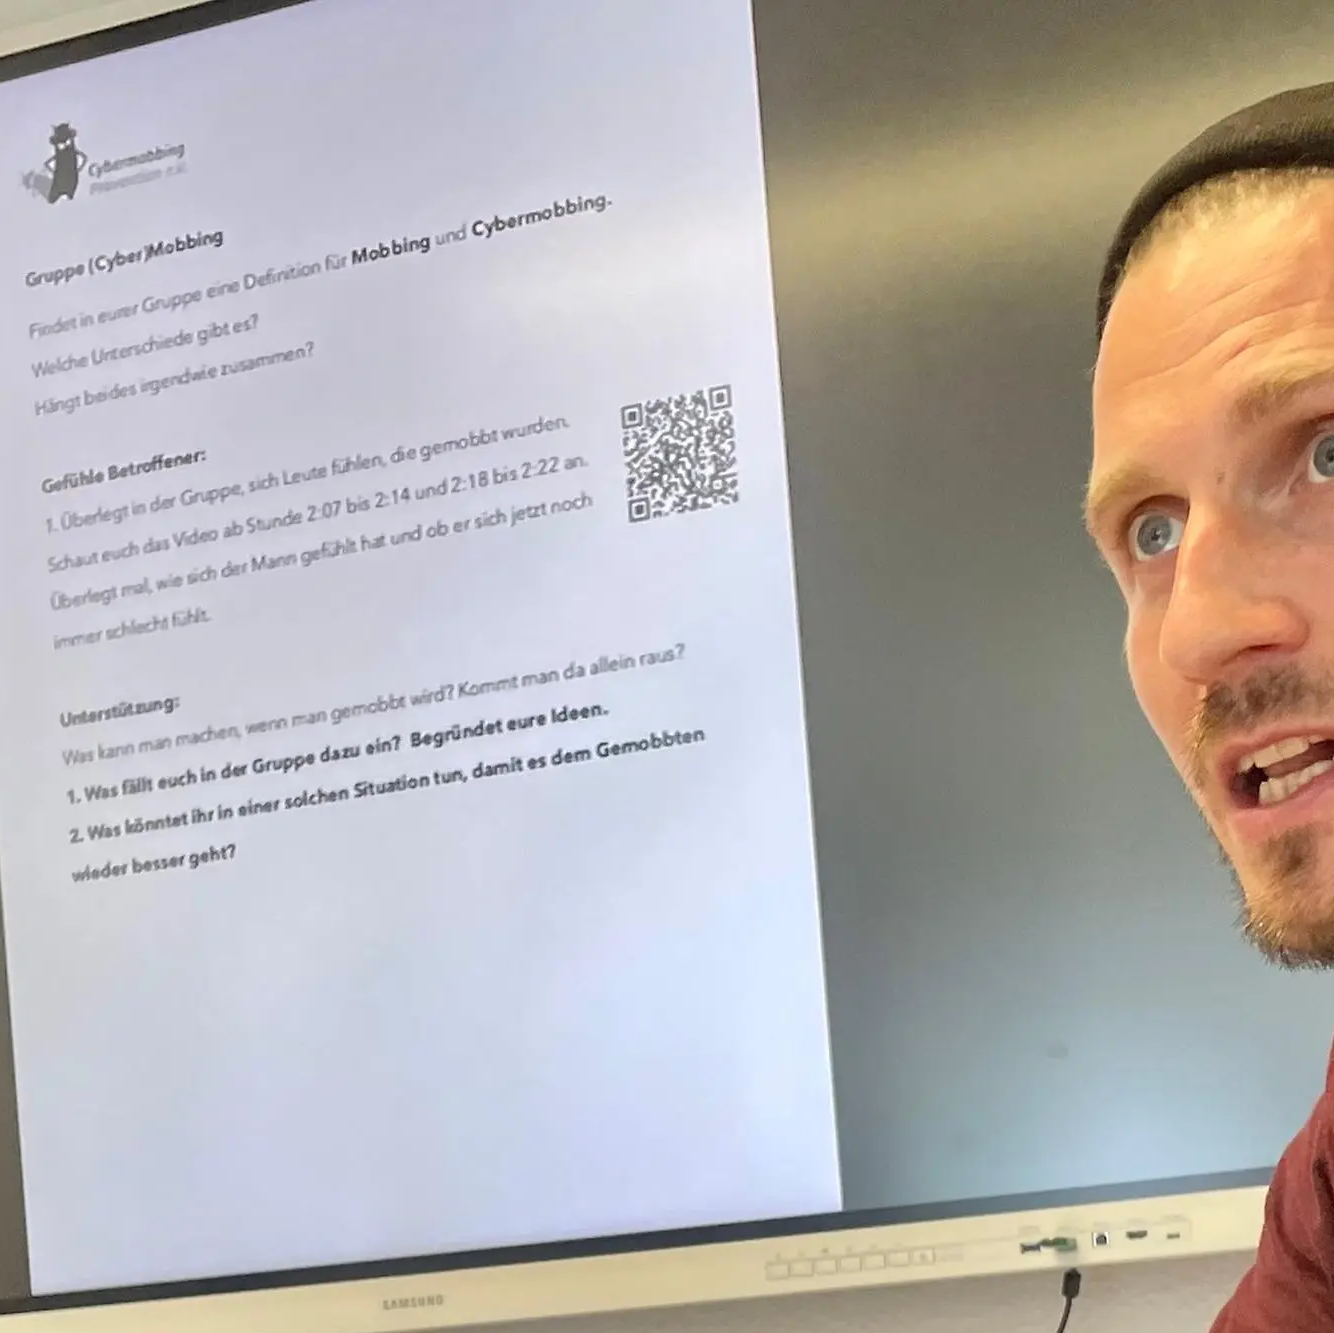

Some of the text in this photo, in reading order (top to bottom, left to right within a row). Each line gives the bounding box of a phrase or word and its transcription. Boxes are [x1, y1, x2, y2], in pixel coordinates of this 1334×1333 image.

[25, 264, 86, 288] Gruppe
[79, 313, 94, 328] in
[97, 305, 139, 325] eurer
[141, 291, 202, 314] Gruppe
[207, 281, 241, 300] eine
[243, 263, 321, 289] Definition
[325, 254, 349, 272] für
[351, 236, 431, 266] Mobbing
[435, 223, 467, 246] und
[471, 195, 613, 238] Cybermobbing.
[32, 313, 258, 378] Welche Unterschiede gibt es?
[83, 383, 136, 407] beides
[42, 451, 206, 494] Gefühle Betroffener:
[48, 552, 99, 574] Schaut
[101, 542, 139, 563] euch
[143, 538, 170, 555] das
[173, 528, 218, 549] Video
[223, 520, 243, 539] ab
[246, 509, 303, 535] Stunde
[307, 500, 341, 523] 2:07
[346, 497, 371, 515] bis
[375, 487, 411, 509] 2:14
[413, 478, 448, 501] und
[451, 471, 489, 494] 2:18
[492, 466, 520, 486] bis
[520, 457, 559, 480] 2:22
[131, 502, 147, 517] in
[150, 496, 176, 514] der
[248, 473, 280, 494] sich
[282, 467, 327, 486] Leute
[388, 446, 417, 465] die
[419, 430, 498, 463] gemobbt
[156, 574, 183, 592] wie
[187, 565, 218, 586] sich
[221, 561, 248, 579] der
[250, 554, 297, 573] Mann
[360, 534, 386, 552] hat
[390, 524, 424, 546] und
[425, 521, 449, 539] ob
[453, 520, 470, 534] er
[474, 508, 507, 530] sich
[510, 503, 548, 528] jetzt
[550, 491, 594, 515] noch
[58, 697, 182, 729] Unterstützung:
[62, 749, 94, 767] Was
[97, 744, 135, 761] kann
[138, 738, 172, 753] man
[245, 718, 288, 735] wenn
[292, 711, 327, 728] man
[331, 694, 407, 726] gemobbt
[410, 685, 454, 707] wird?
[457, 676, 519, 699] Kommt
[521, 670, 560, 688] man
[563, 662, 586, 681] da
[589, 655, 635, 676] allein
[639, 643, 685, 667] raus?
[70, 730, 705, 845] 2. Was könntet ihr in einer solchen Situation tun, damit es dem Gemobbten
[84, 785, 119, 803] Was
[121, 777, 153, 796] fällt
[158, 769, 197, 791] euch
[200, 767, 218, 783] in
[220, 763, 248, 780] der
[251, 754, 316, 775] Gruppe
[319, 746, 361, 764] dazu
[365, 736, 407, 756] ein?
[409, 719, 503, 750] Begründet
[506, 714, 547, 732] eure
[550, 705, 611, 724] Ideen.
[72, 844, 236, 883] wieder besser geht?
